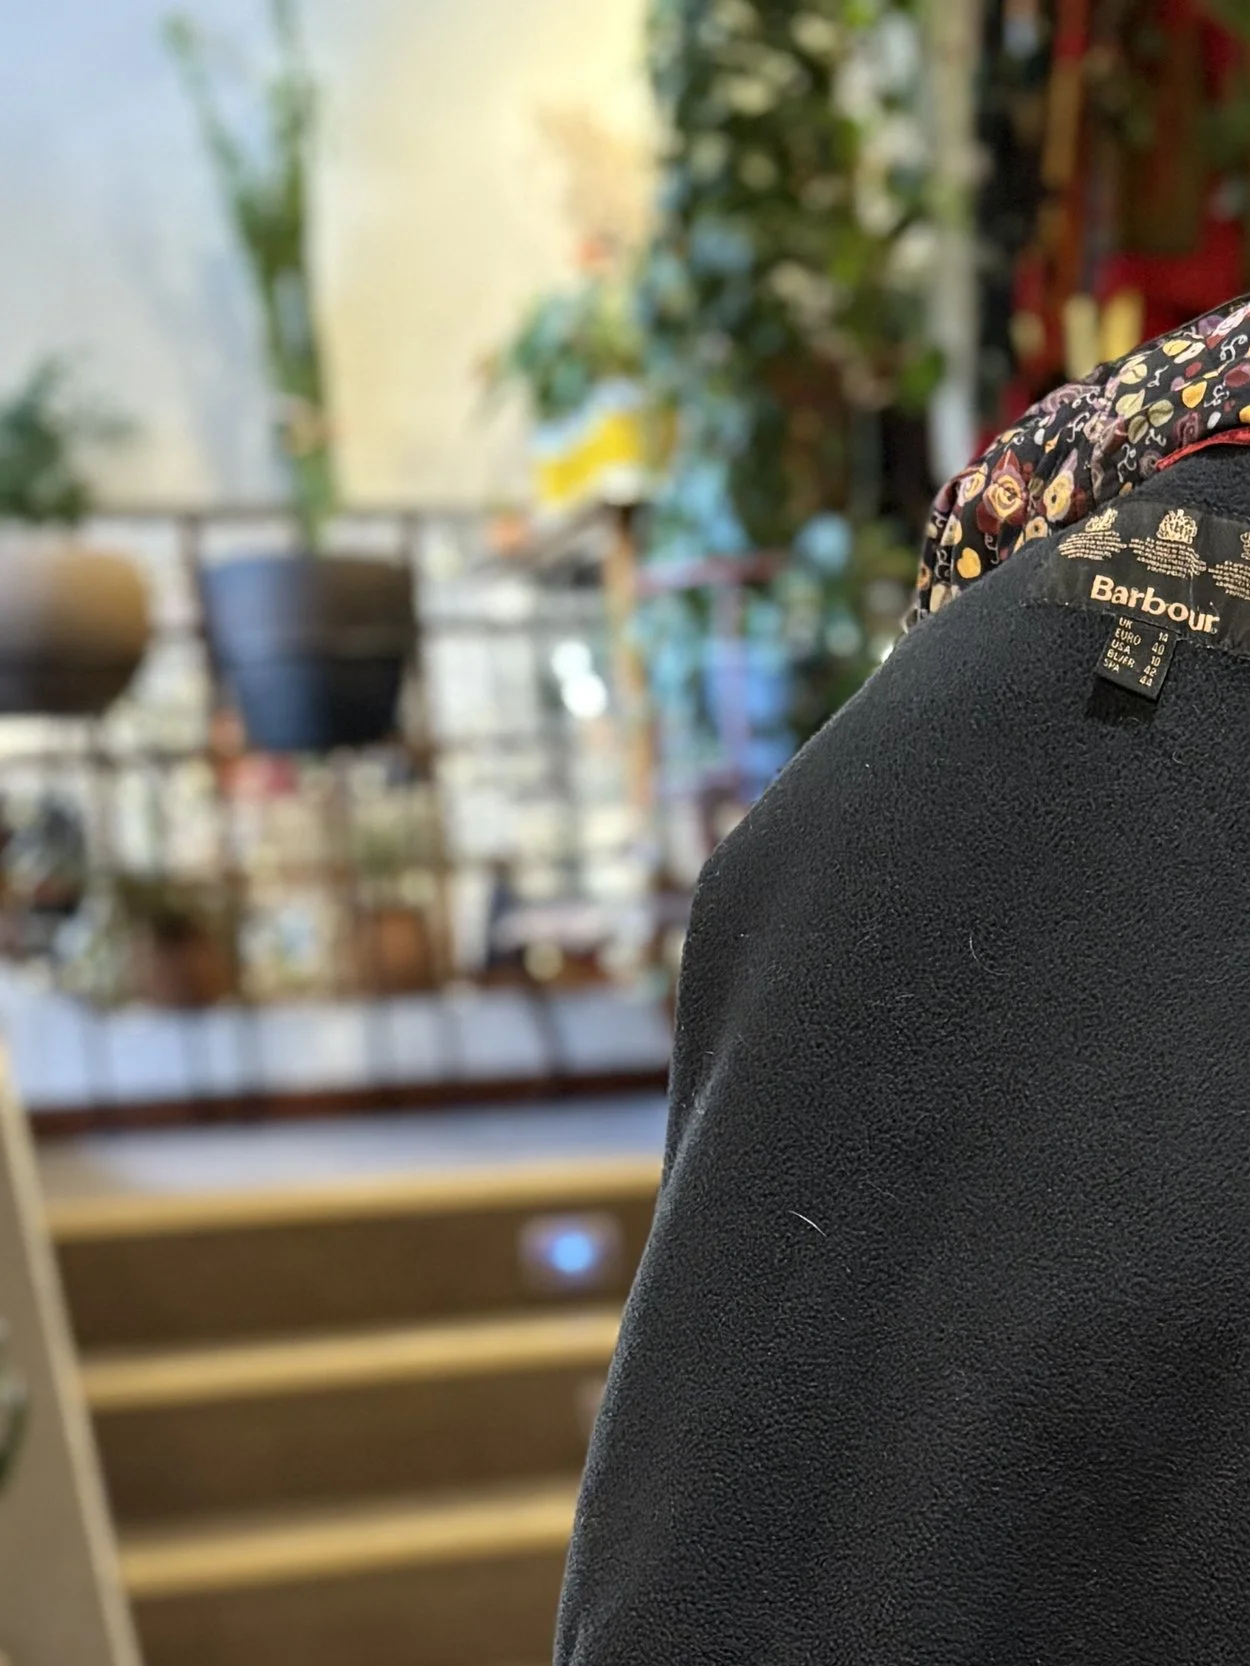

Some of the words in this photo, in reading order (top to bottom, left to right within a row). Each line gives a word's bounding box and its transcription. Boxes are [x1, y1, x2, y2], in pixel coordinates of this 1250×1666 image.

[1090, 574, 1220, 633] Barbour
[1115, 628, 1141, 646] EURO
[1151, 642, 1165, 655] 40
[1119, 617, 1133, 629] UK
[1158, 632, 1169, 642] 14
[1107, 648, 1135, 668] BL/FR
[1143, 665, 1157, 677] 42
[1111, 639, 1131, 655] USA
[1151, 656, 1161, 667] 10
[1103, 658, 1120, 674] SPA
[1139, 675, 1153, 687] 44
